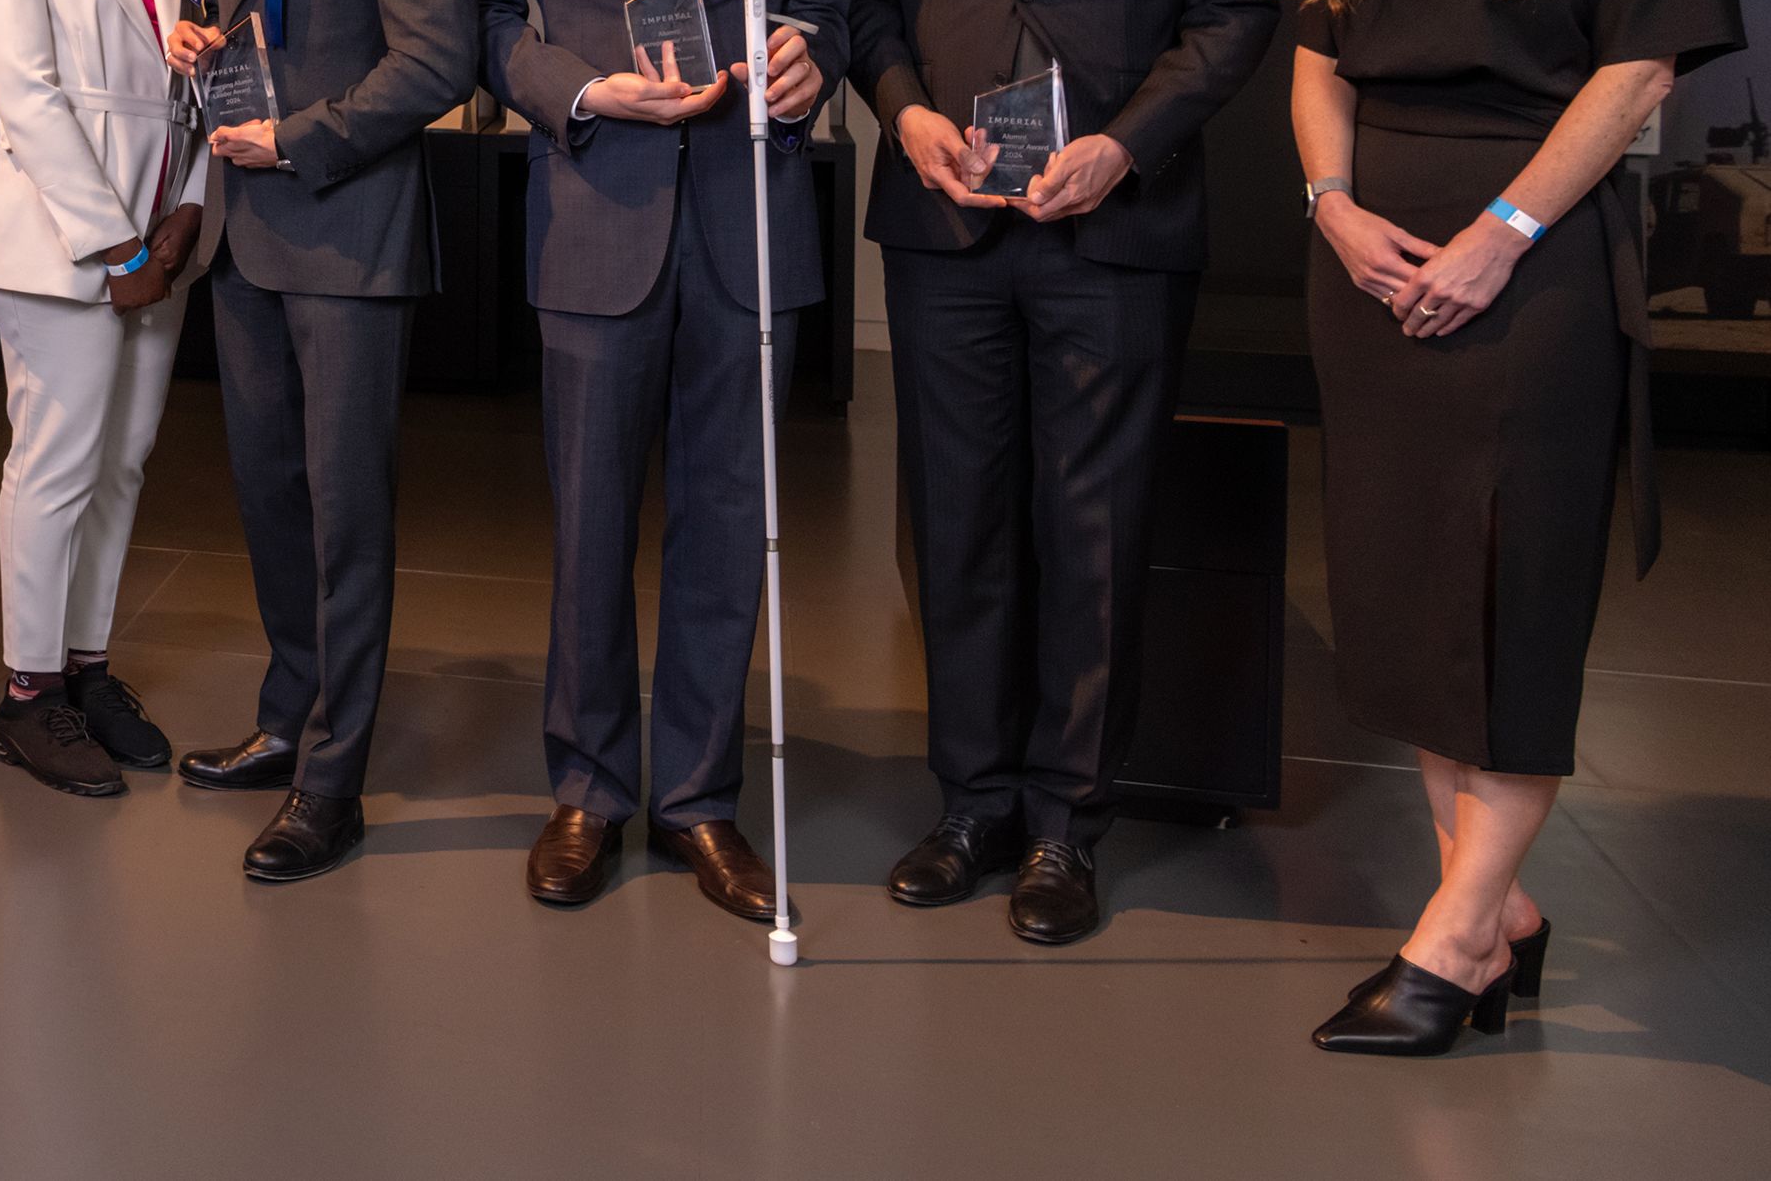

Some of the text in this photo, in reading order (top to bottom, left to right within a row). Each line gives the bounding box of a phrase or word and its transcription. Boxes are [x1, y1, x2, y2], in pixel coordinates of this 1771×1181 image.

[641, 11, 693, 26] IMPERIAL
[206, 63, 251, 77] IMPERIAL
[987, 116, 1044, 127] IMPERIAL
[1026, 143, 1049, 152] Award
